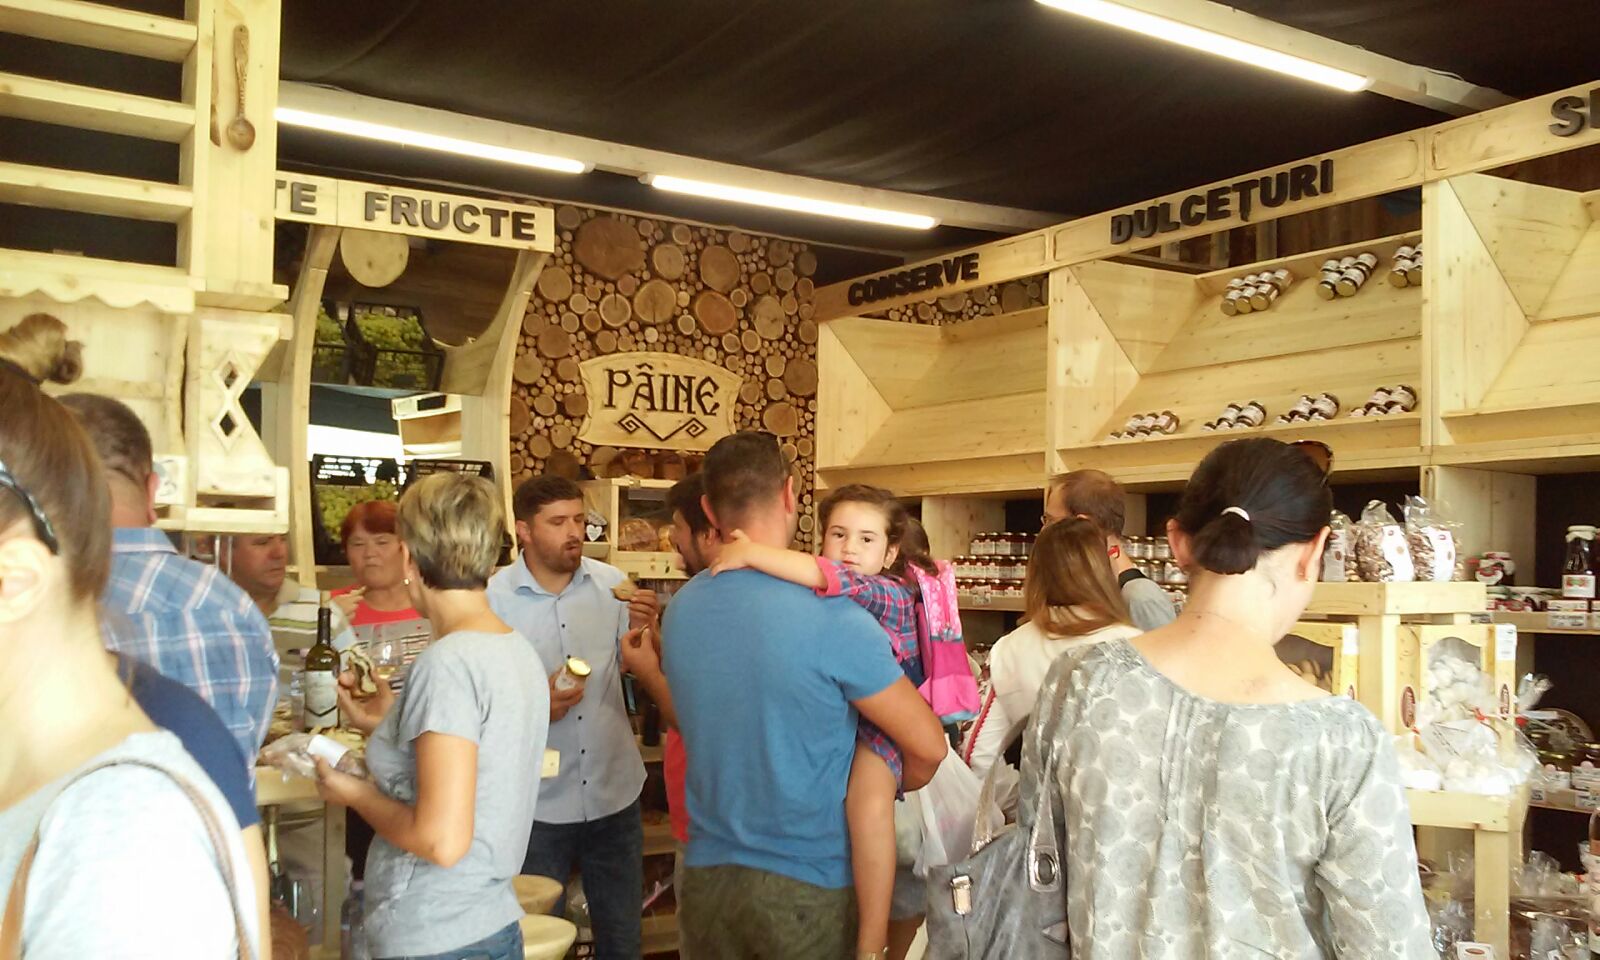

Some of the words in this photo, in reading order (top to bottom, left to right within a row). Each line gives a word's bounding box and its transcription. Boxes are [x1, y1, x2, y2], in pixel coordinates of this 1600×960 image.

[364, 190, 536, 242] FRUCTE
[847, 252, 980, 307] CONSERVE
[603, 362, 721, 417] PÂINE
